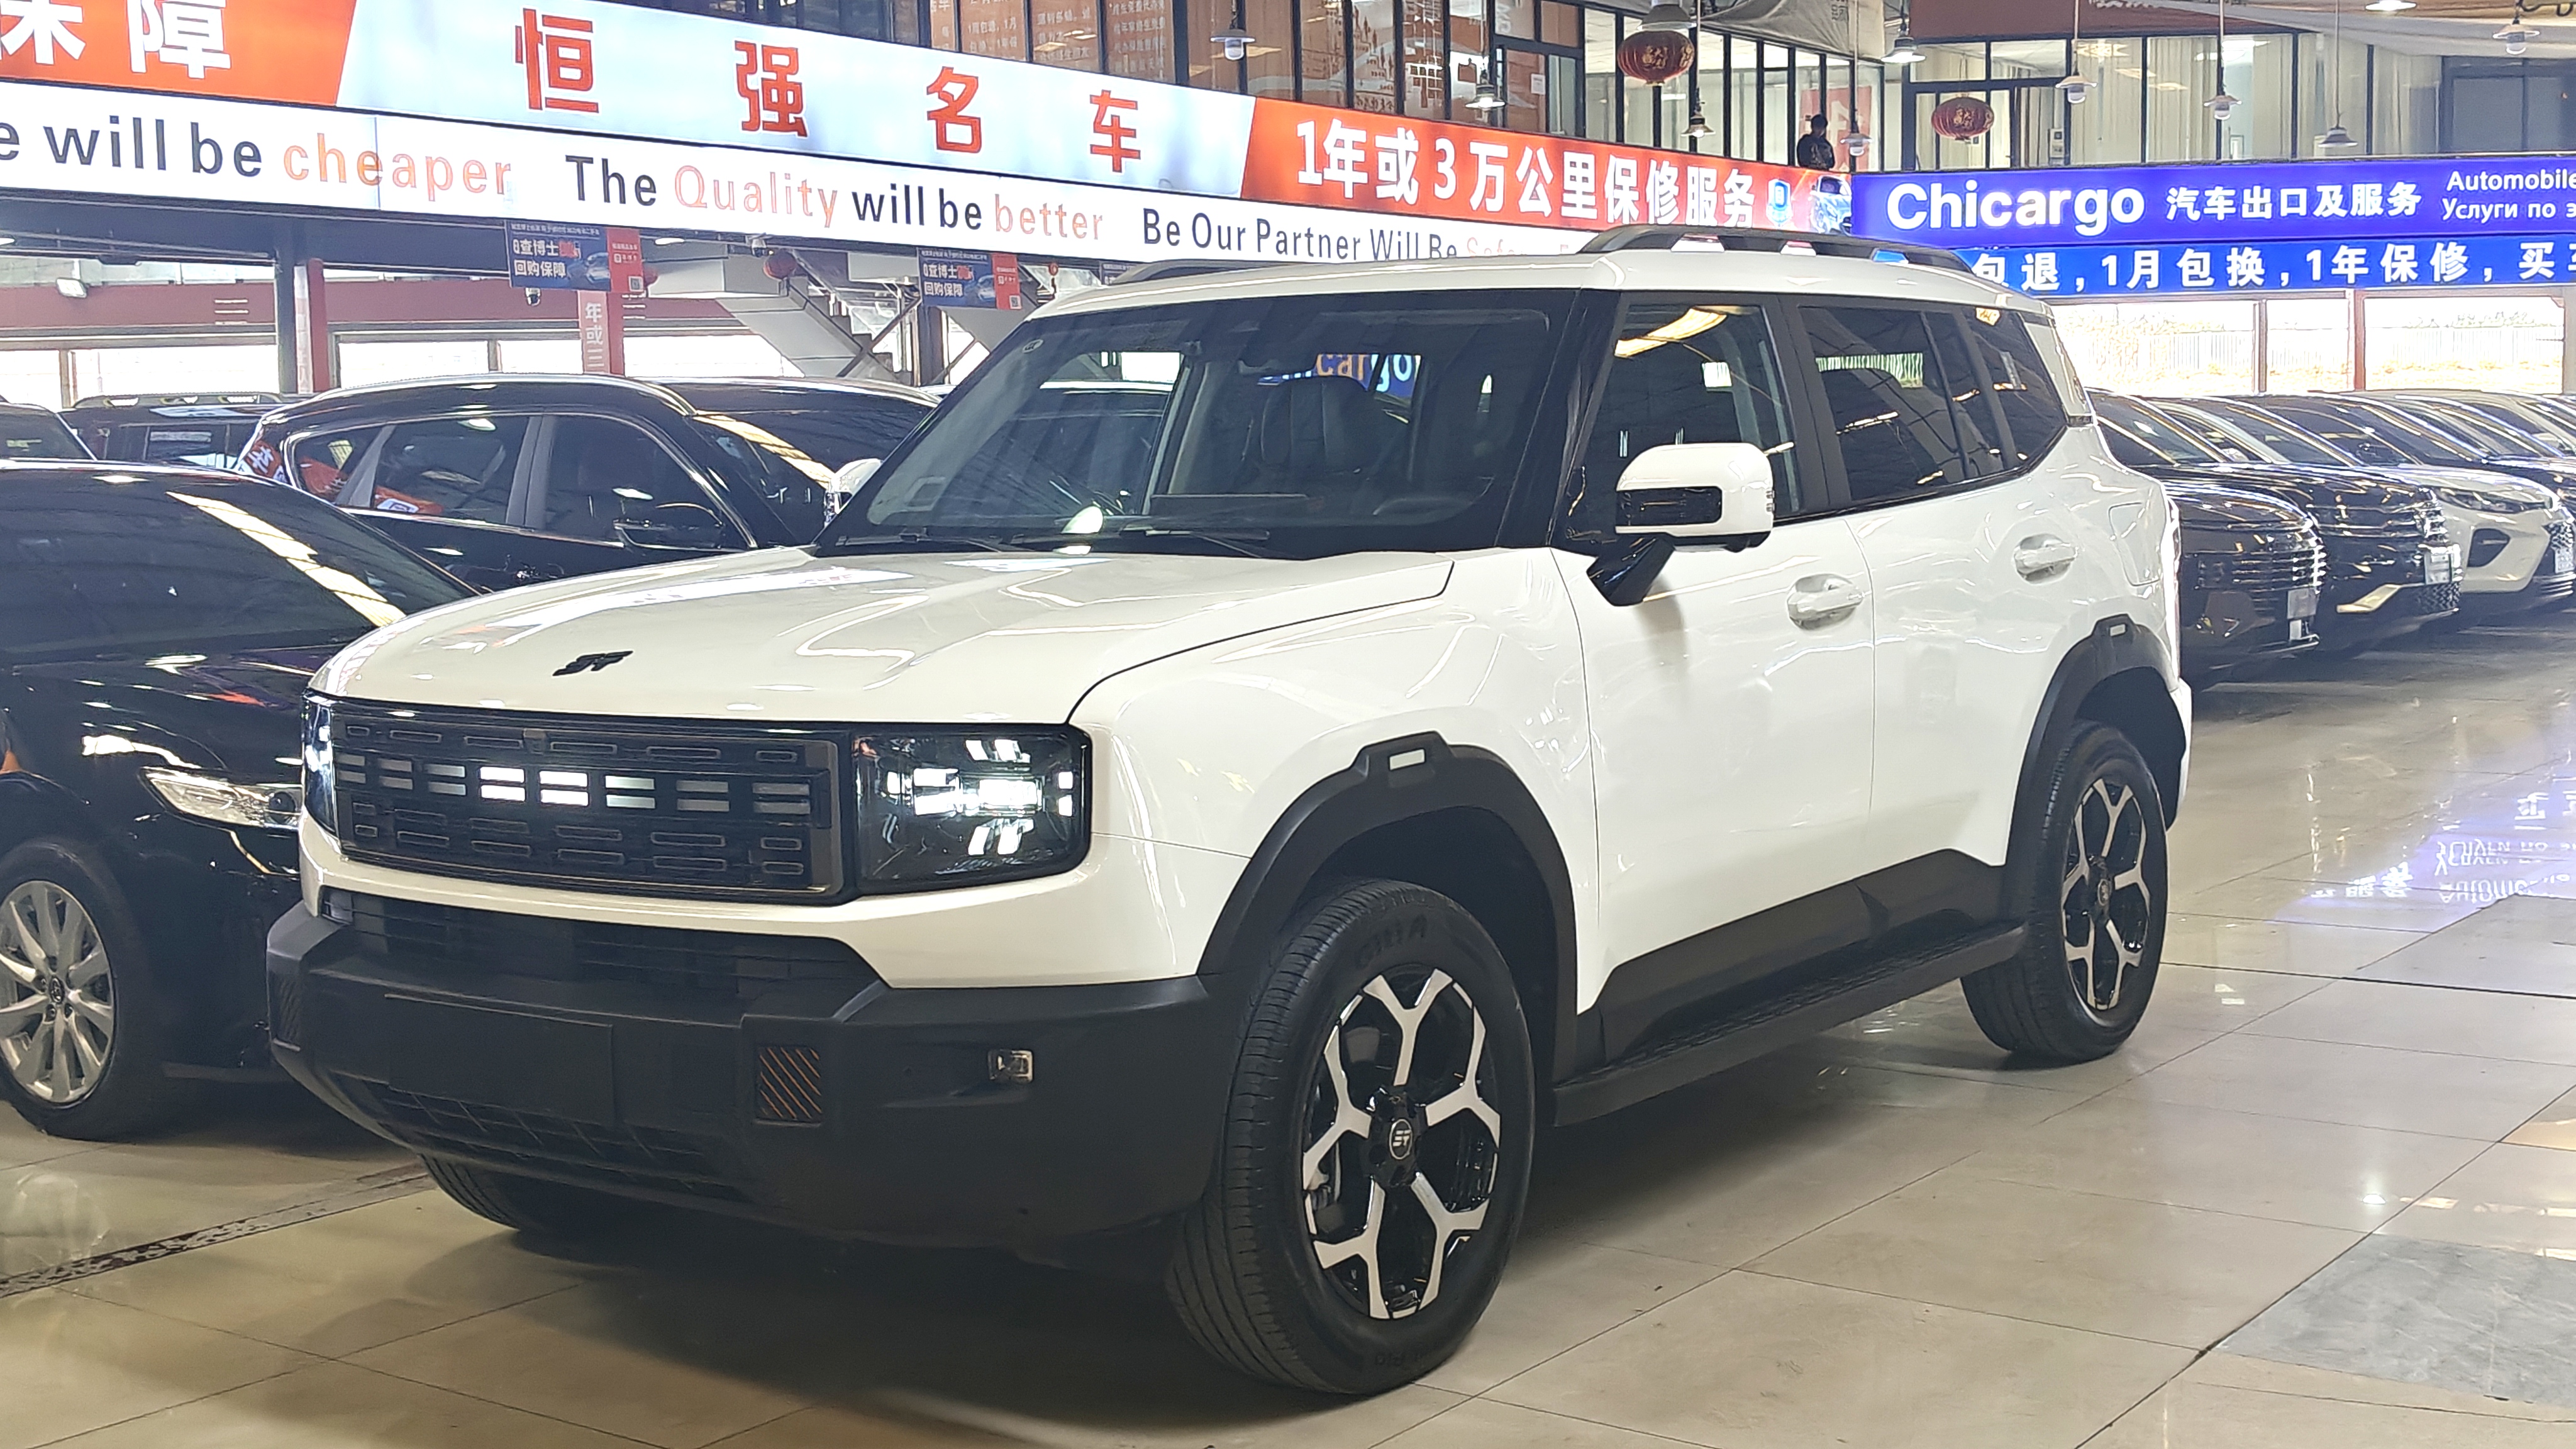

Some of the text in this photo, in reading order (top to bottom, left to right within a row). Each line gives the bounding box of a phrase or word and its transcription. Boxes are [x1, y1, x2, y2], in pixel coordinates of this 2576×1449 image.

[514, 8, 1141, 174] 恒强名车
[43, 115, 166, 170] will
[190, 121, 262, 177] be
[284, 133, 511, 202] cheaper
[565, 155, 657, 206] The
[675, 165, 838, 228] Quality
[852, 183, 924, 226] will
[939, 188, 982, 230] be
[995, 194, 1102, 240] better
[1143, 208, 1180, 247] Be
[1192, 213, 1246, 251] Our
[1257, 218, 1360, 260] Partner
[1370, 228, 1419, 260] Will
[1887, 180, 2145, 236] Chicargo
[2166, 182, 2421, 221] 汽车出口及服务
[2443, 198, 2518, 223] Услуги
[2528, 203, 2556, 218] по
